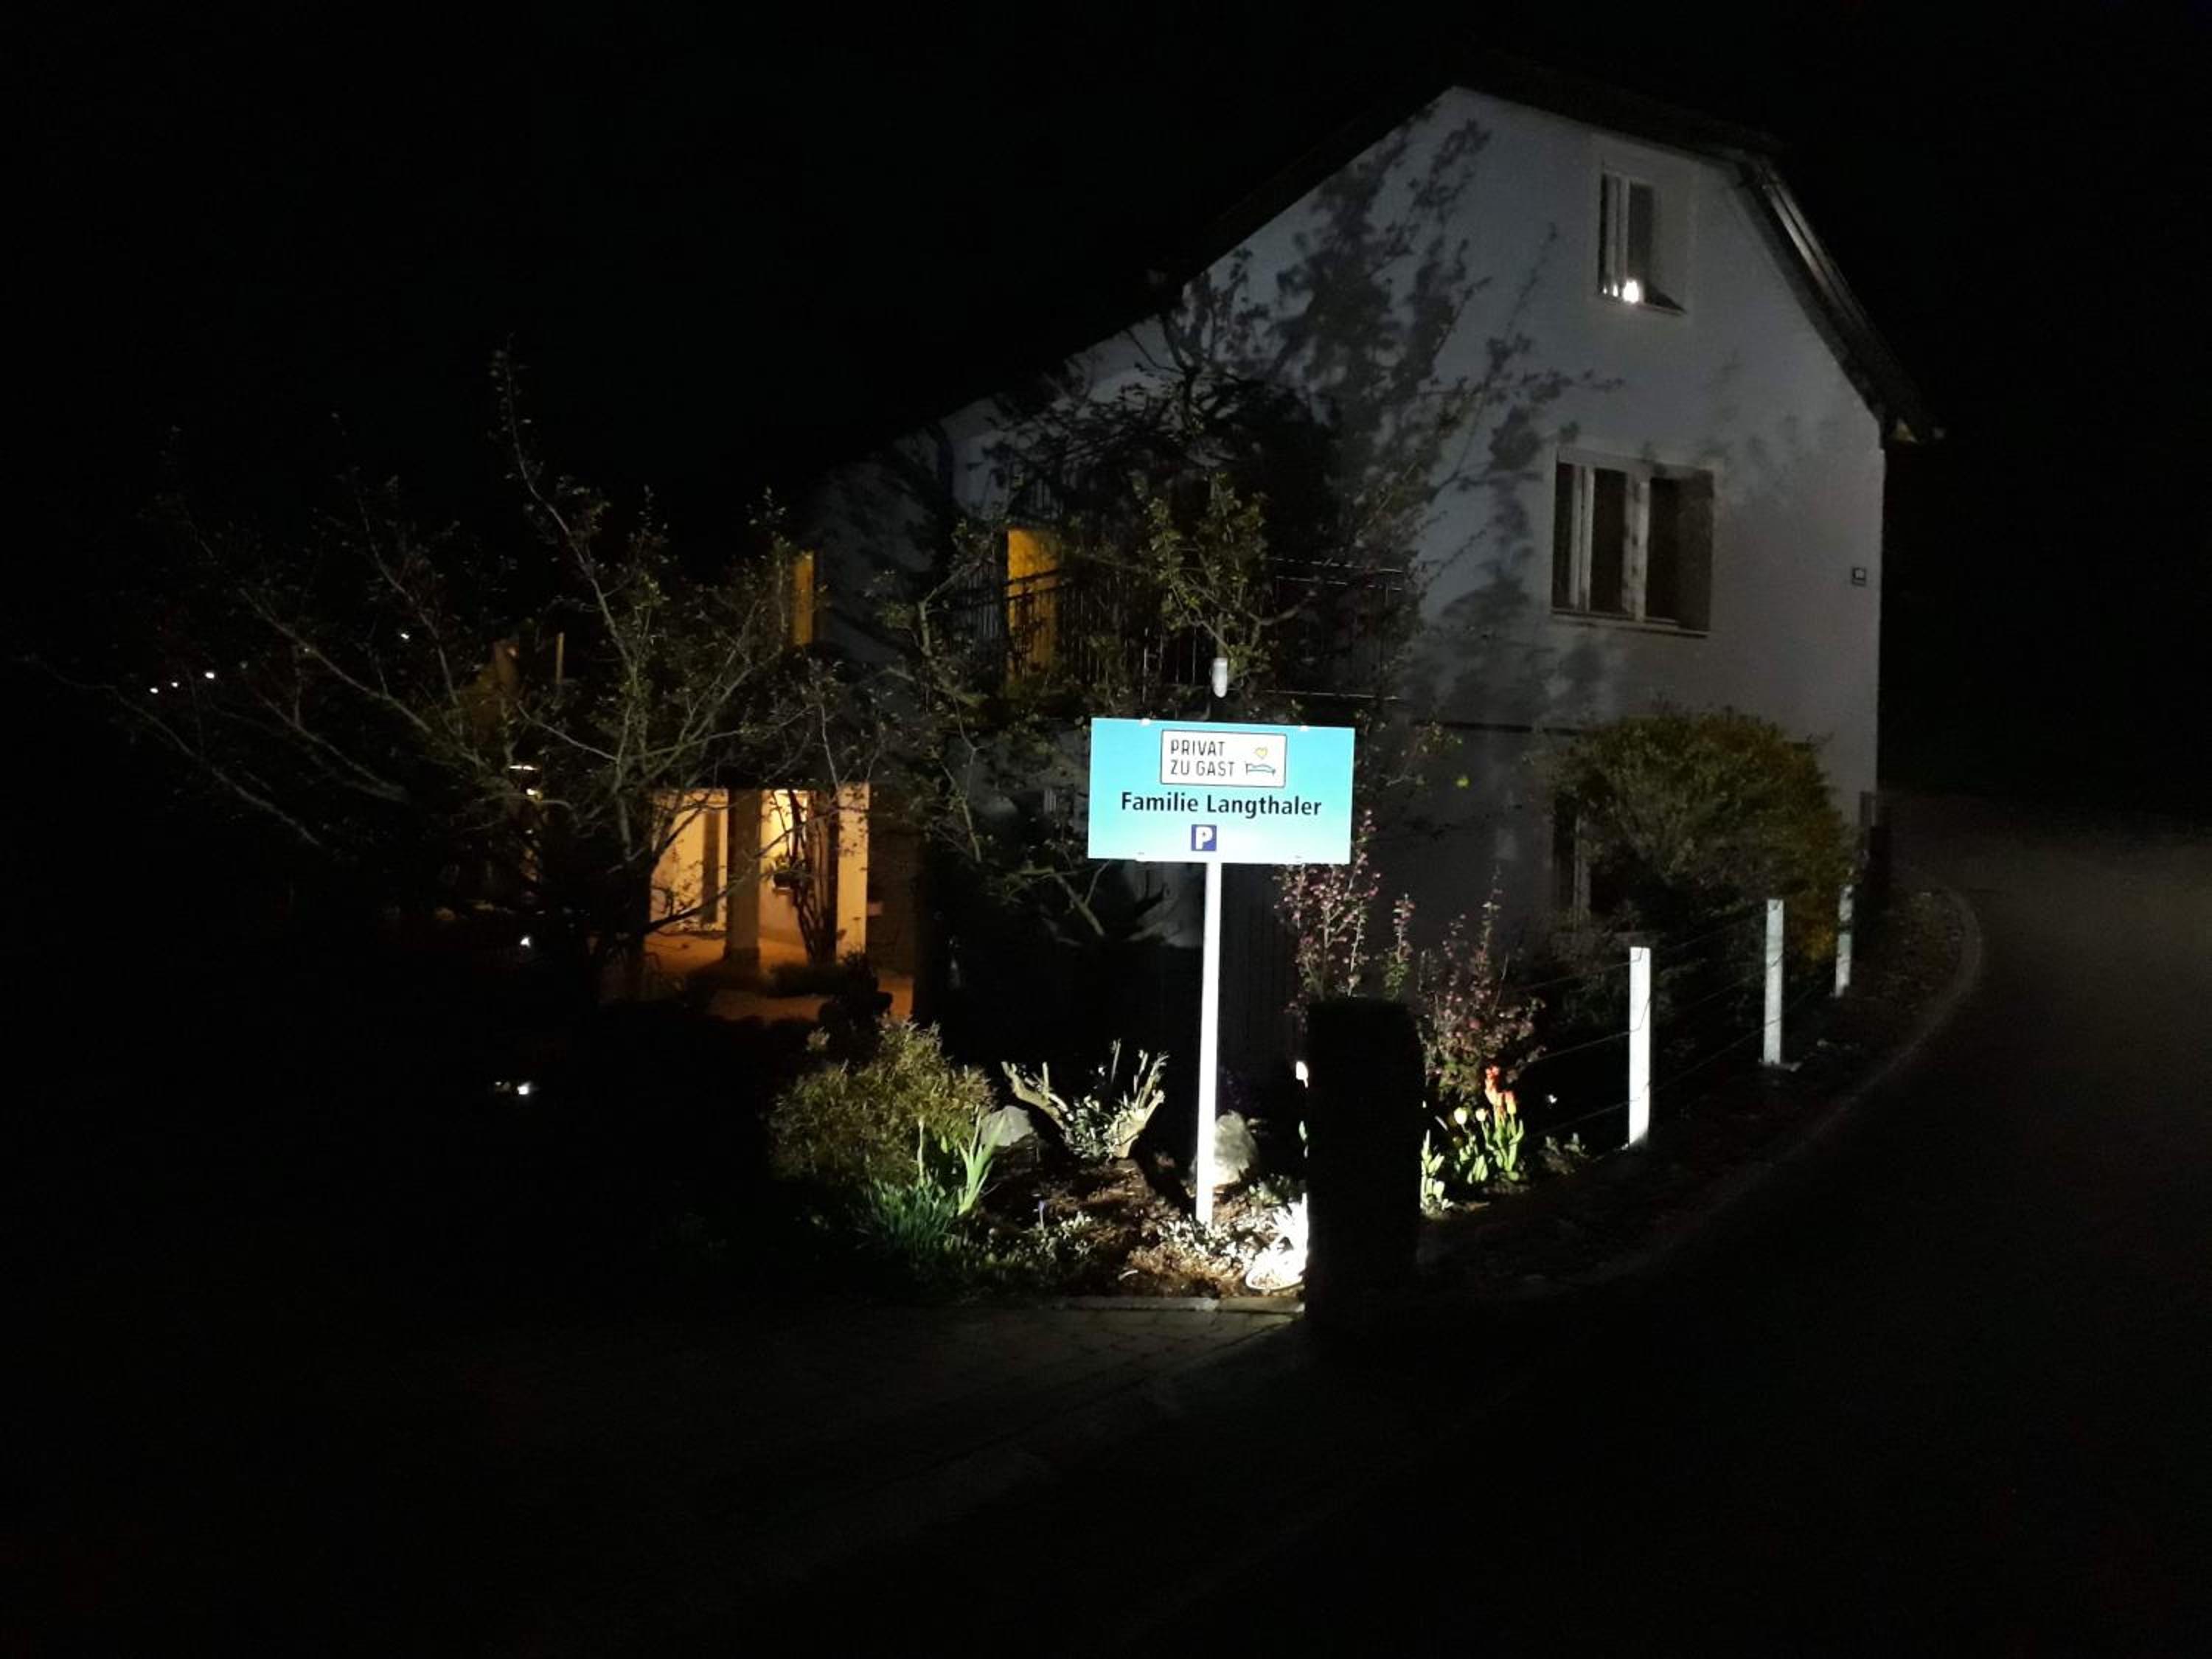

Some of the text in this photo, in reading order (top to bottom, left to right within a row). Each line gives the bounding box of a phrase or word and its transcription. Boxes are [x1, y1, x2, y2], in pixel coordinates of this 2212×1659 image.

[1170, 739, 1225, 757] PRIVAT
[1170, 760, 1235, 777] ZU GAST
[1121, 791, 1322, 818] Familie Langthaler
[1195, 827, 1213, 849] P
